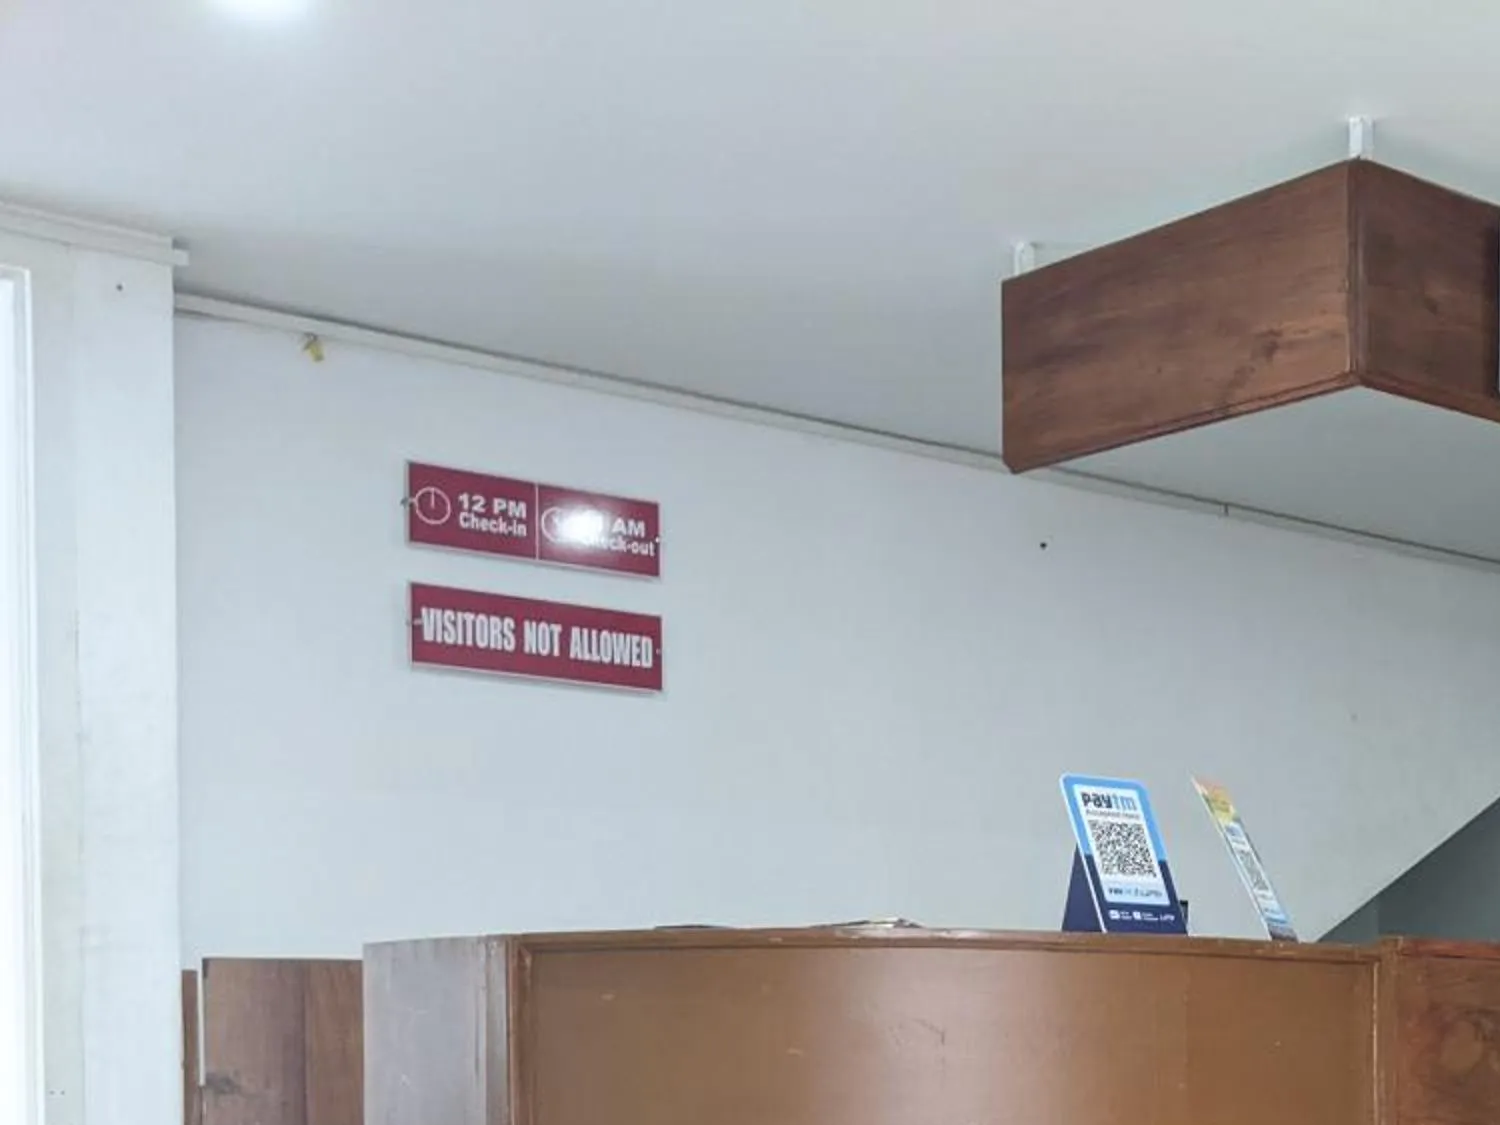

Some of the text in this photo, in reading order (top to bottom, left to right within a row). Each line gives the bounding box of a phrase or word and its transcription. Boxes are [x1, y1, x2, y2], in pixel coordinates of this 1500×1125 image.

[457, 492, 527, 519] 12 PM
[458, 511, 527, 537] Check-in
[610, 517, 646, 539] AM
[420, 606, 653, 669] VISITORS NOT ALLOWED
